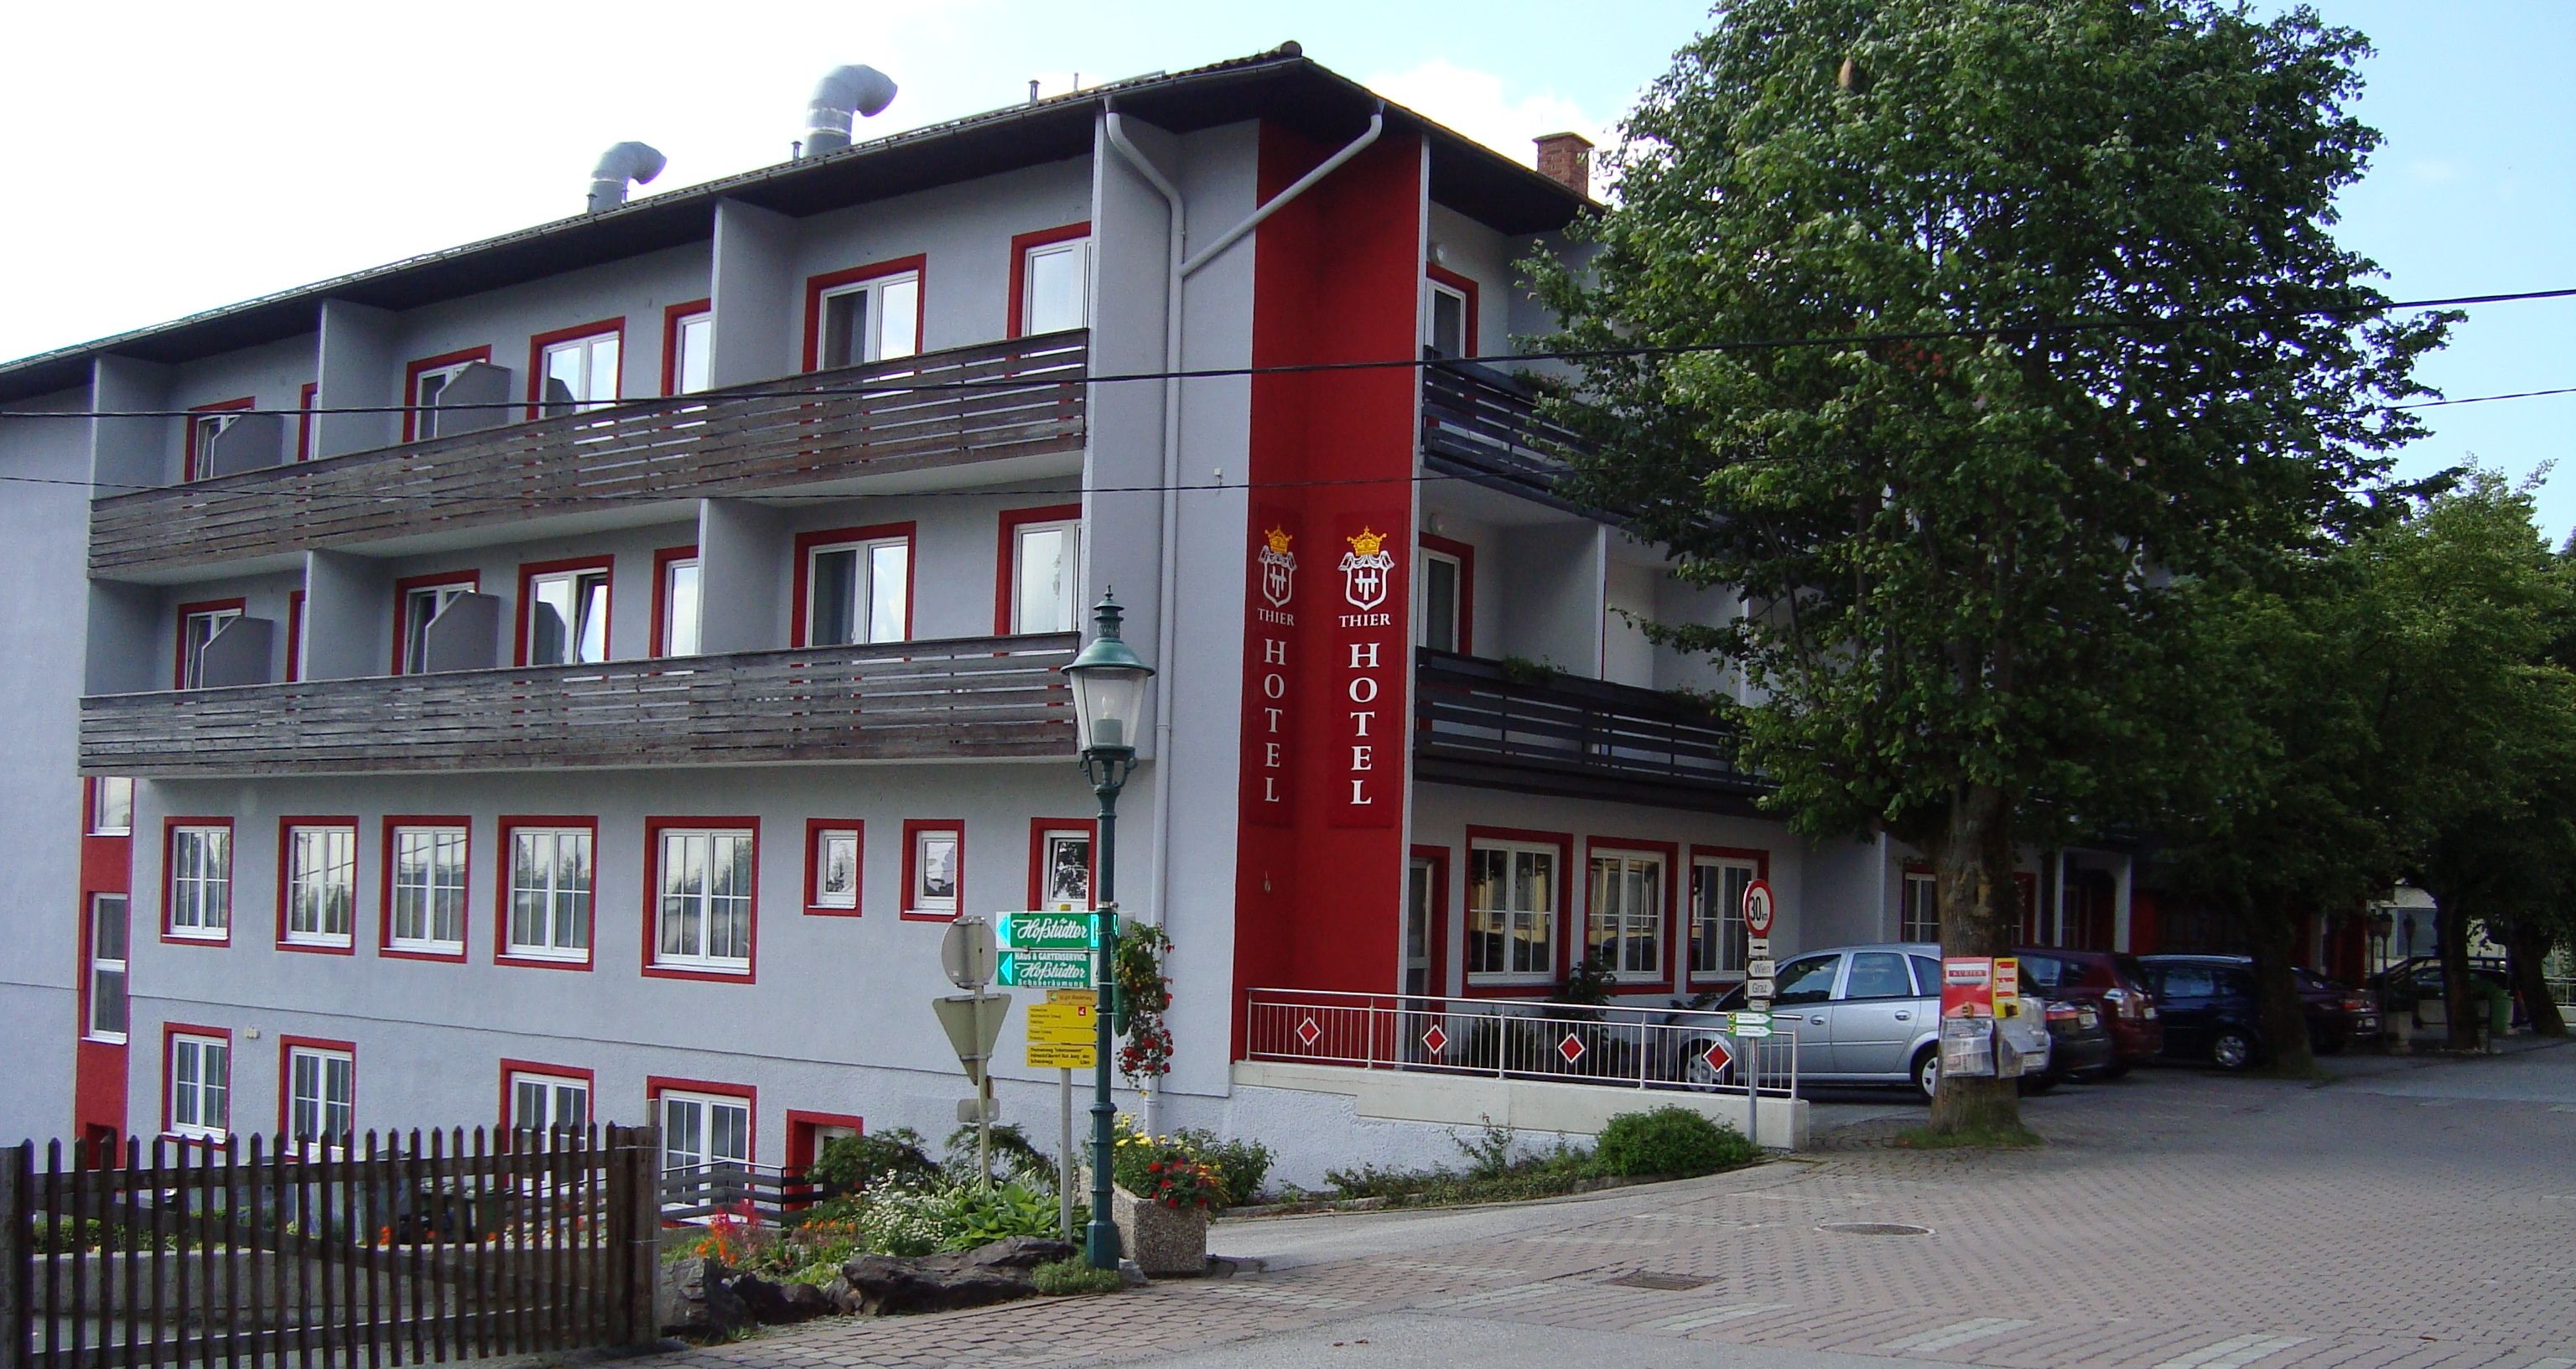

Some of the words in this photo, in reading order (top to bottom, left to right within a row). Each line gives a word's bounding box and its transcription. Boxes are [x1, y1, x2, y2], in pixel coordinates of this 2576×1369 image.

[1258, 608, 1295, 626] THIER
[1339, 613, 1391, 627] THIER
[1264, 639, 1286, 802] HOTEL
[1348, 643, 1380, 805] HOTEL
[1750, 895, 1762, 921] 30
[1015, 952, 1031, 961] HAUS
[1038, 952, 1087, 962] GARTENSERVICE
[1753, 962, 1771, 973] Wien
[1752, 983, 1768, 993] Graz
